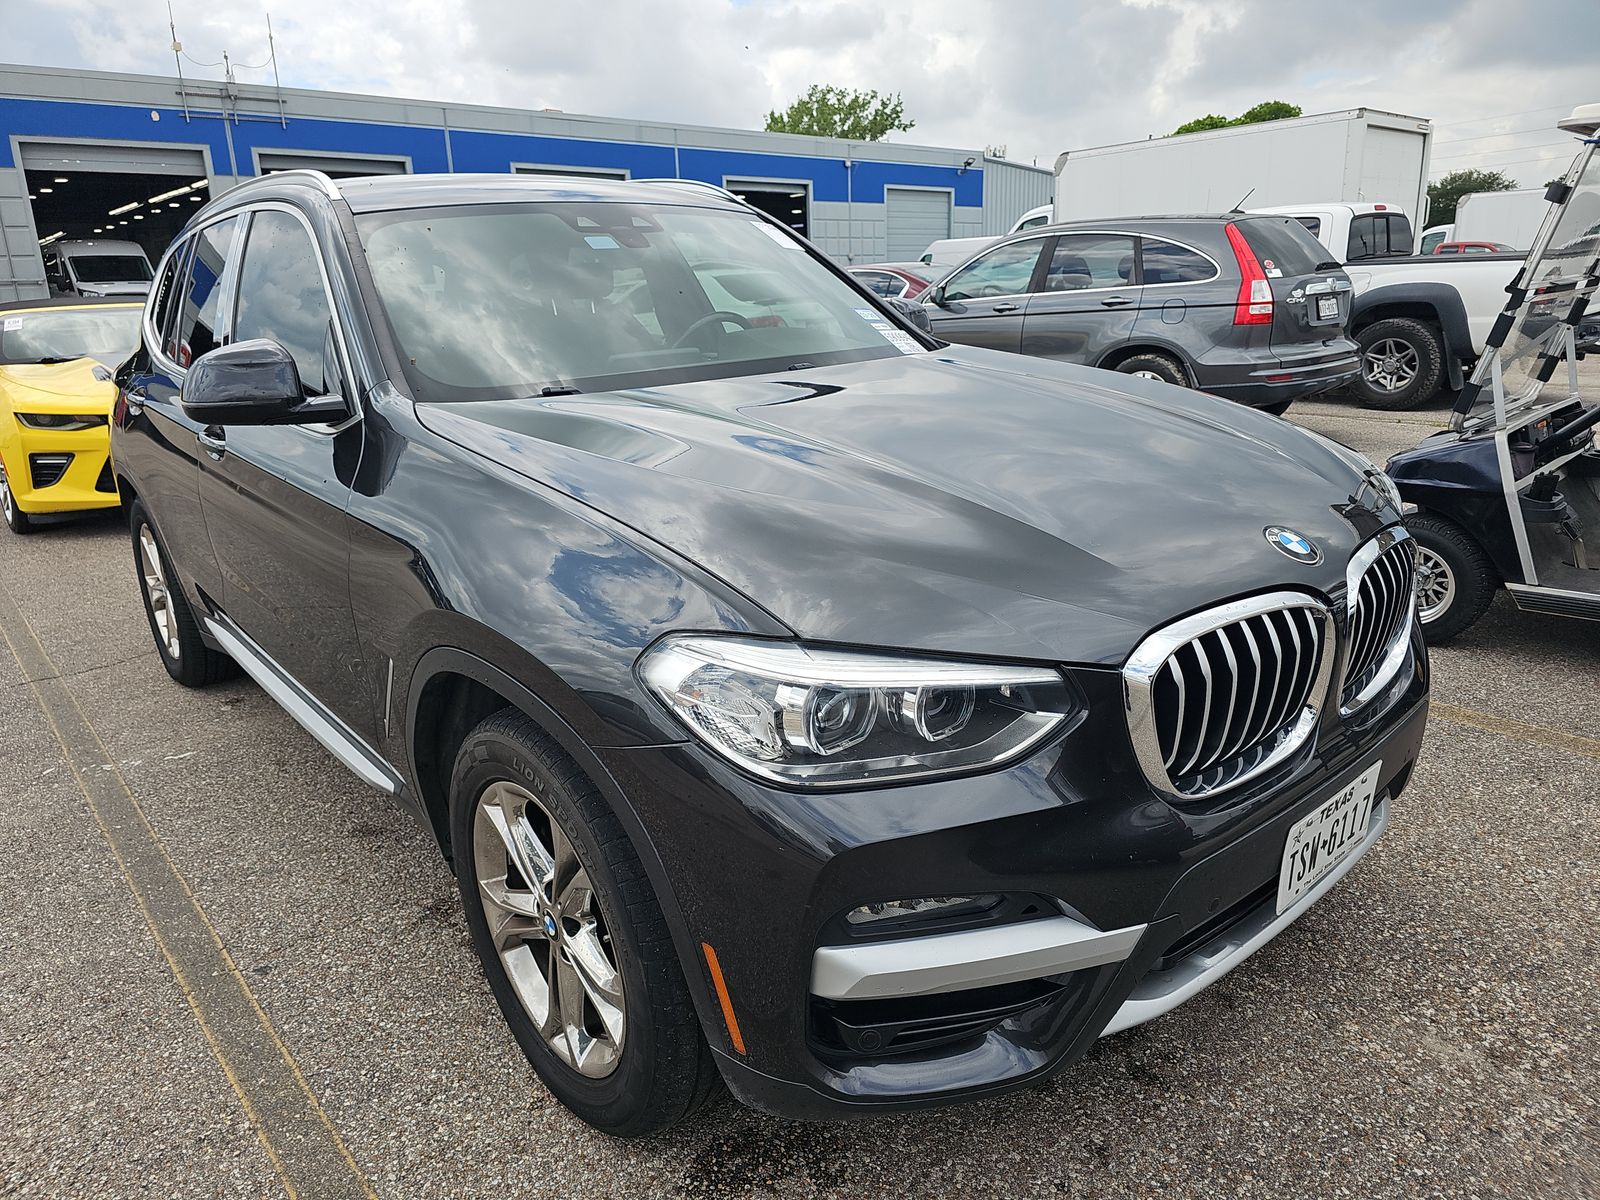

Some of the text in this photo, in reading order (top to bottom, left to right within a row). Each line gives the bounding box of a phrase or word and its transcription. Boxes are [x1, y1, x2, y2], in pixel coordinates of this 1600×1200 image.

[512, 757, 597, 871] LION SPORT
[1319, 786, 1355, 824] TEXAS
[1303, 879, 1311, 887] The
[1312, 868, 1323, 879] Lone
[1334, 850, 1345, 861] State
